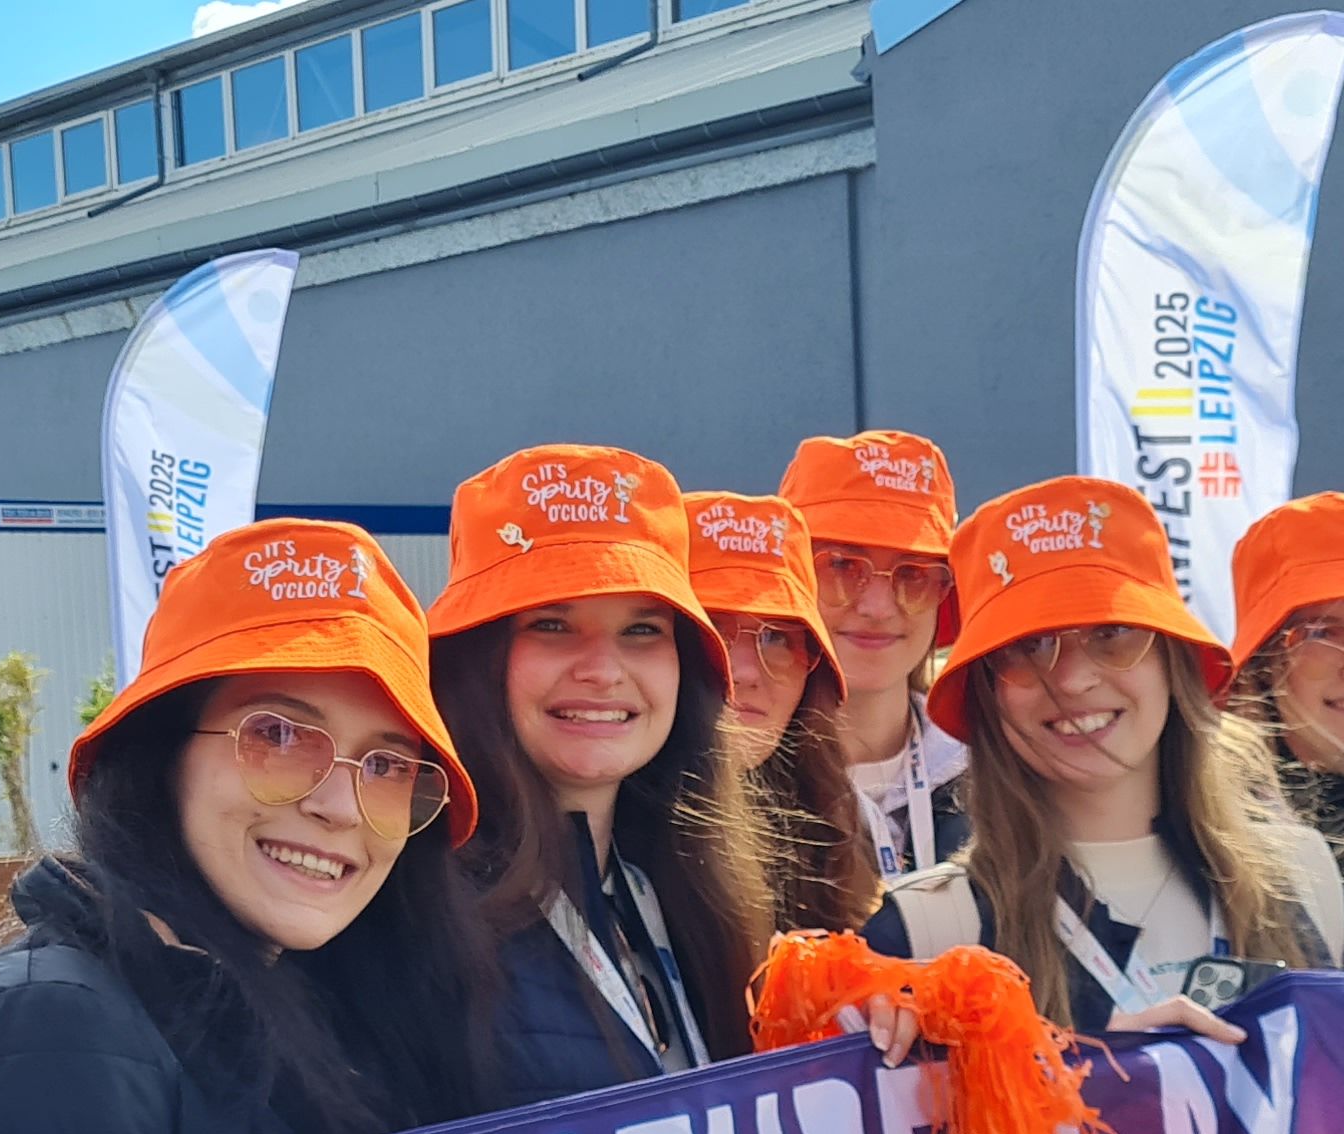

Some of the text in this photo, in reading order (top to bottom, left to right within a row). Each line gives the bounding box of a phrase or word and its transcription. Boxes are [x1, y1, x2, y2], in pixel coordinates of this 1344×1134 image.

[1154, 292, 1192, 379] 2025
[1192, 296, 1238, 445] LEIPZIG
[150, 449, 176, 510] 2025
[538, 463, 568, 481] IT'S
[521, 475, 612, 512] Spritz
[547, 504, 609, 523] O'CLOCK
[1006, 510, 1087, 546] Spritz
[265, 540, 296, 558] IT'S
[1030, 534, 1084, 554] O'CLOCK
[244, 553, 348, 590] Spritz
[271, 581, 341, 600] O'CLOCK
